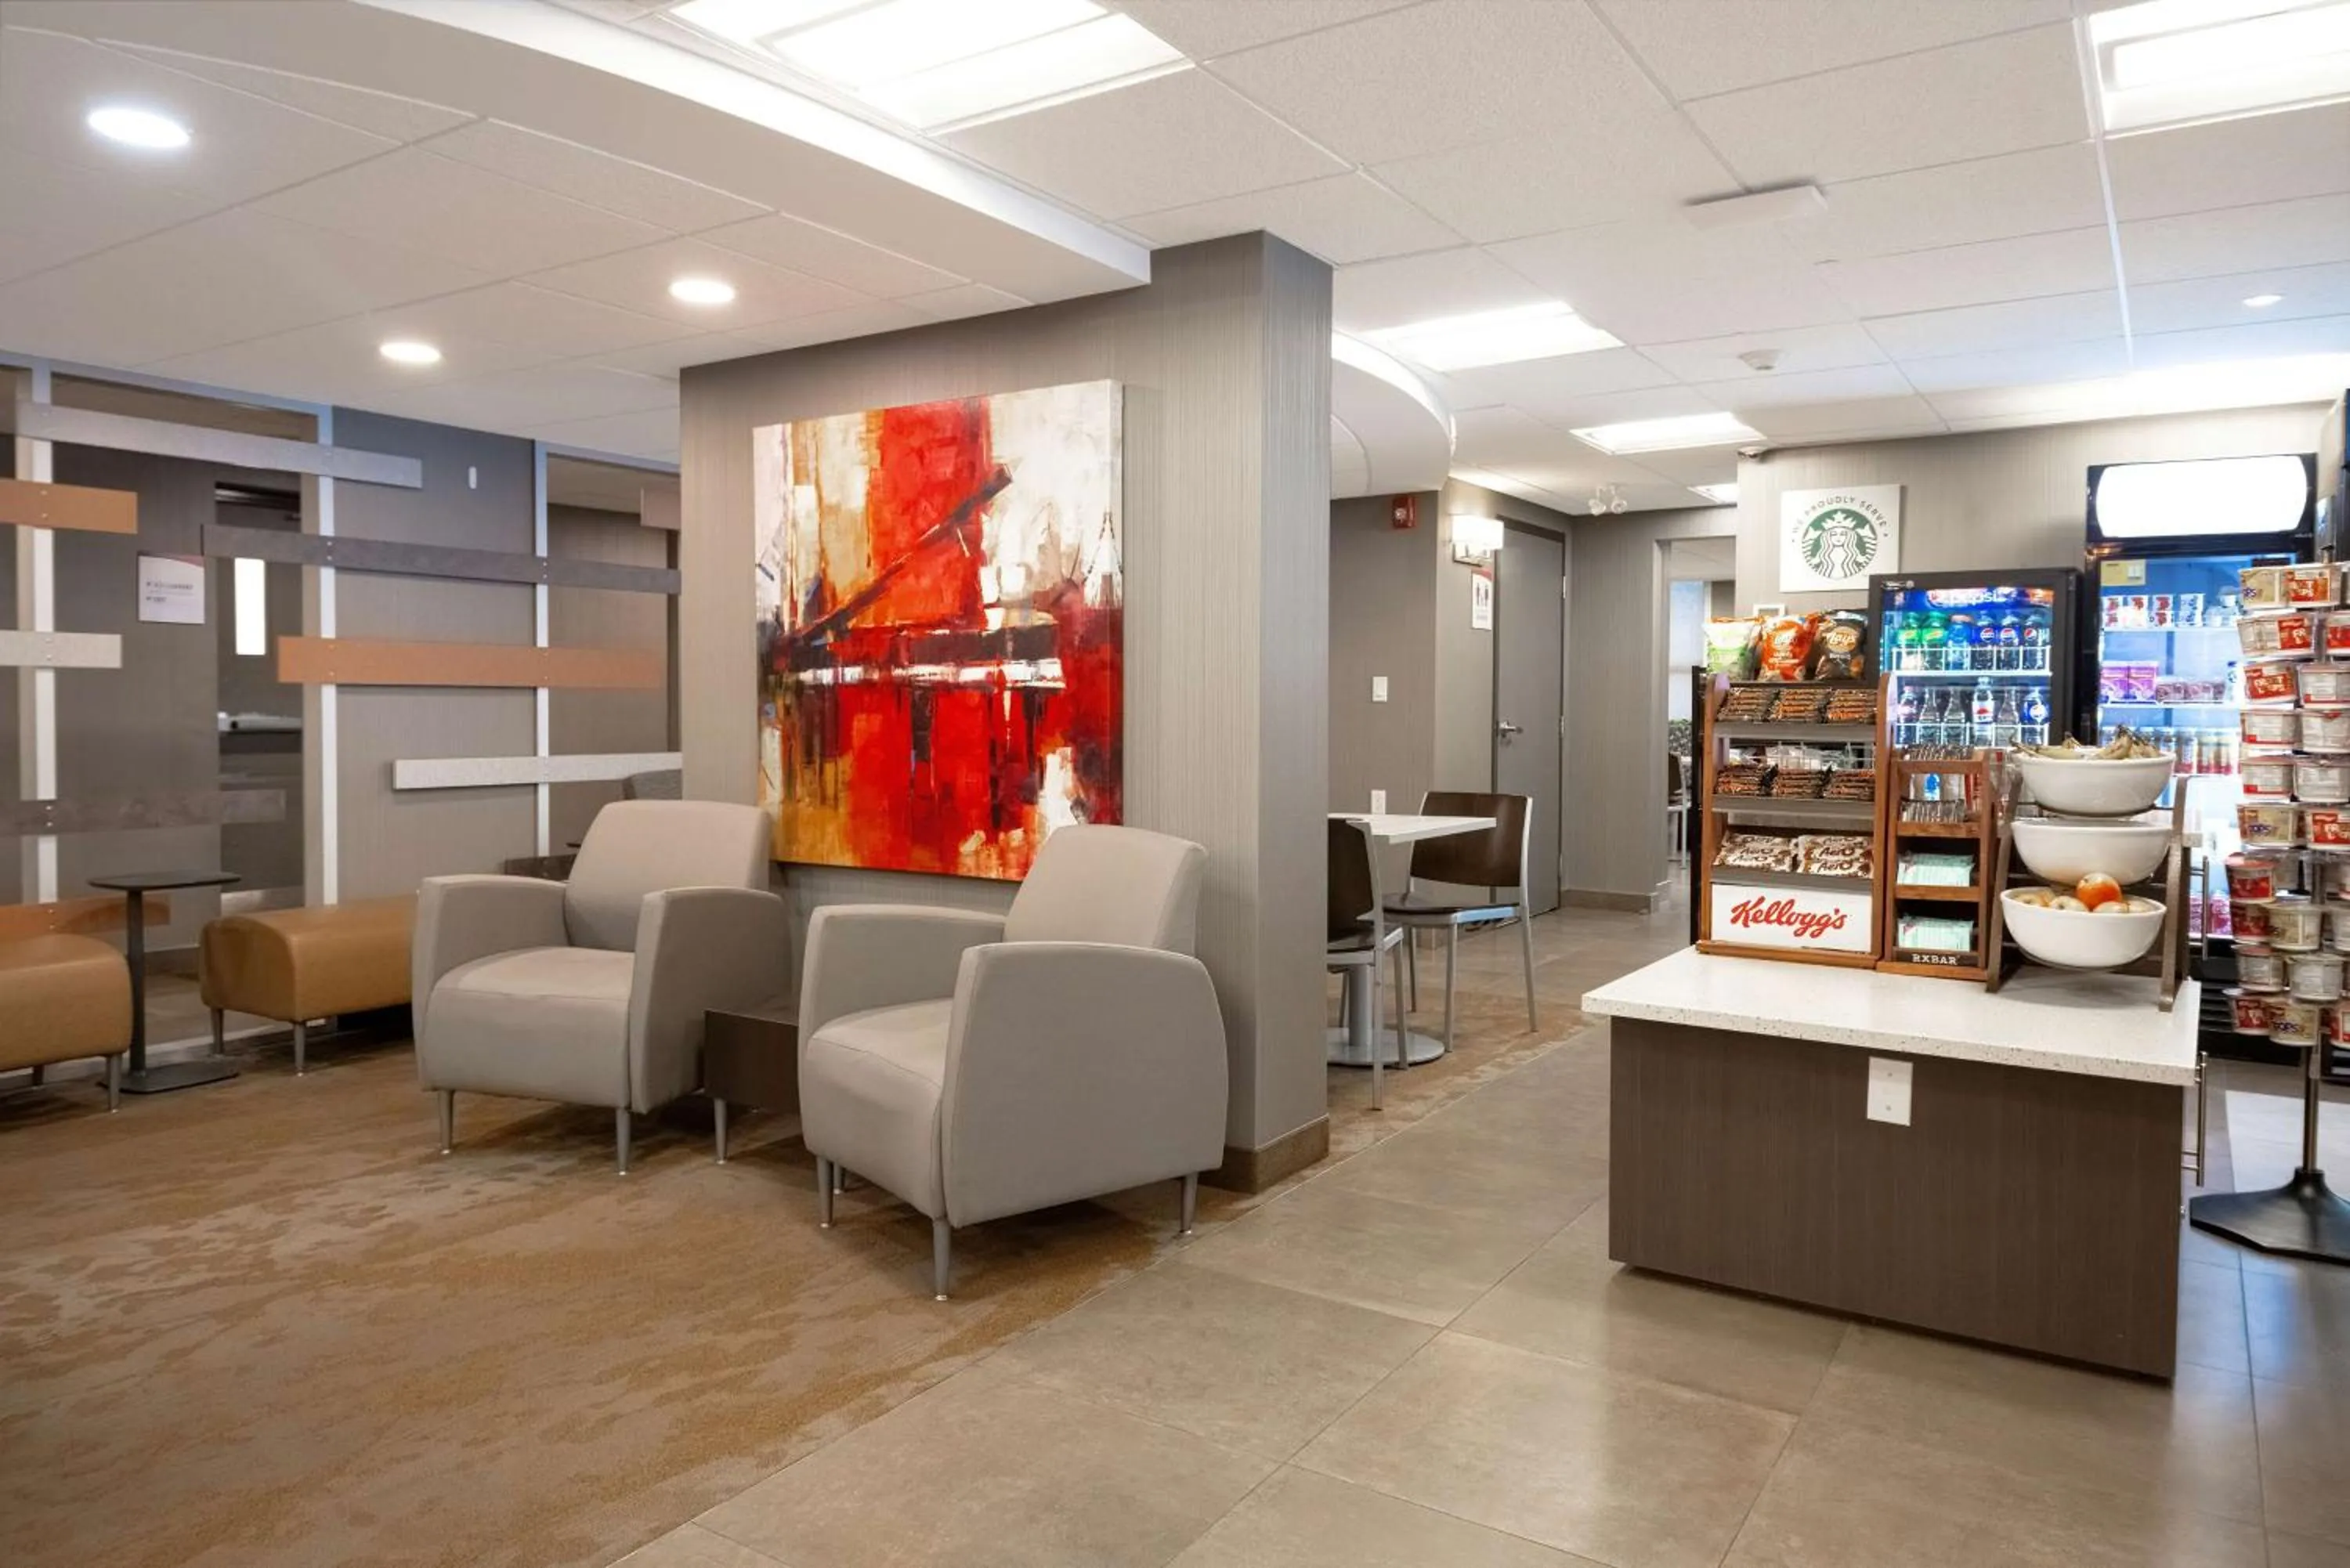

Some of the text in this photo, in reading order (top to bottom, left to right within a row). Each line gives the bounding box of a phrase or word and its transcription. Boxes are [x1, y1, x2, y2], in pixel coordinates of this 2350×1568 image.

[1859, 500, 1887, 527] SERVE
[1818, 847, 1855, 857] Aero
[1817, 862, 1852, 872] Aero
[1730, 896, 1847, 938] Kellogg's
[1911, 954, 1958, 966] RXBAR
